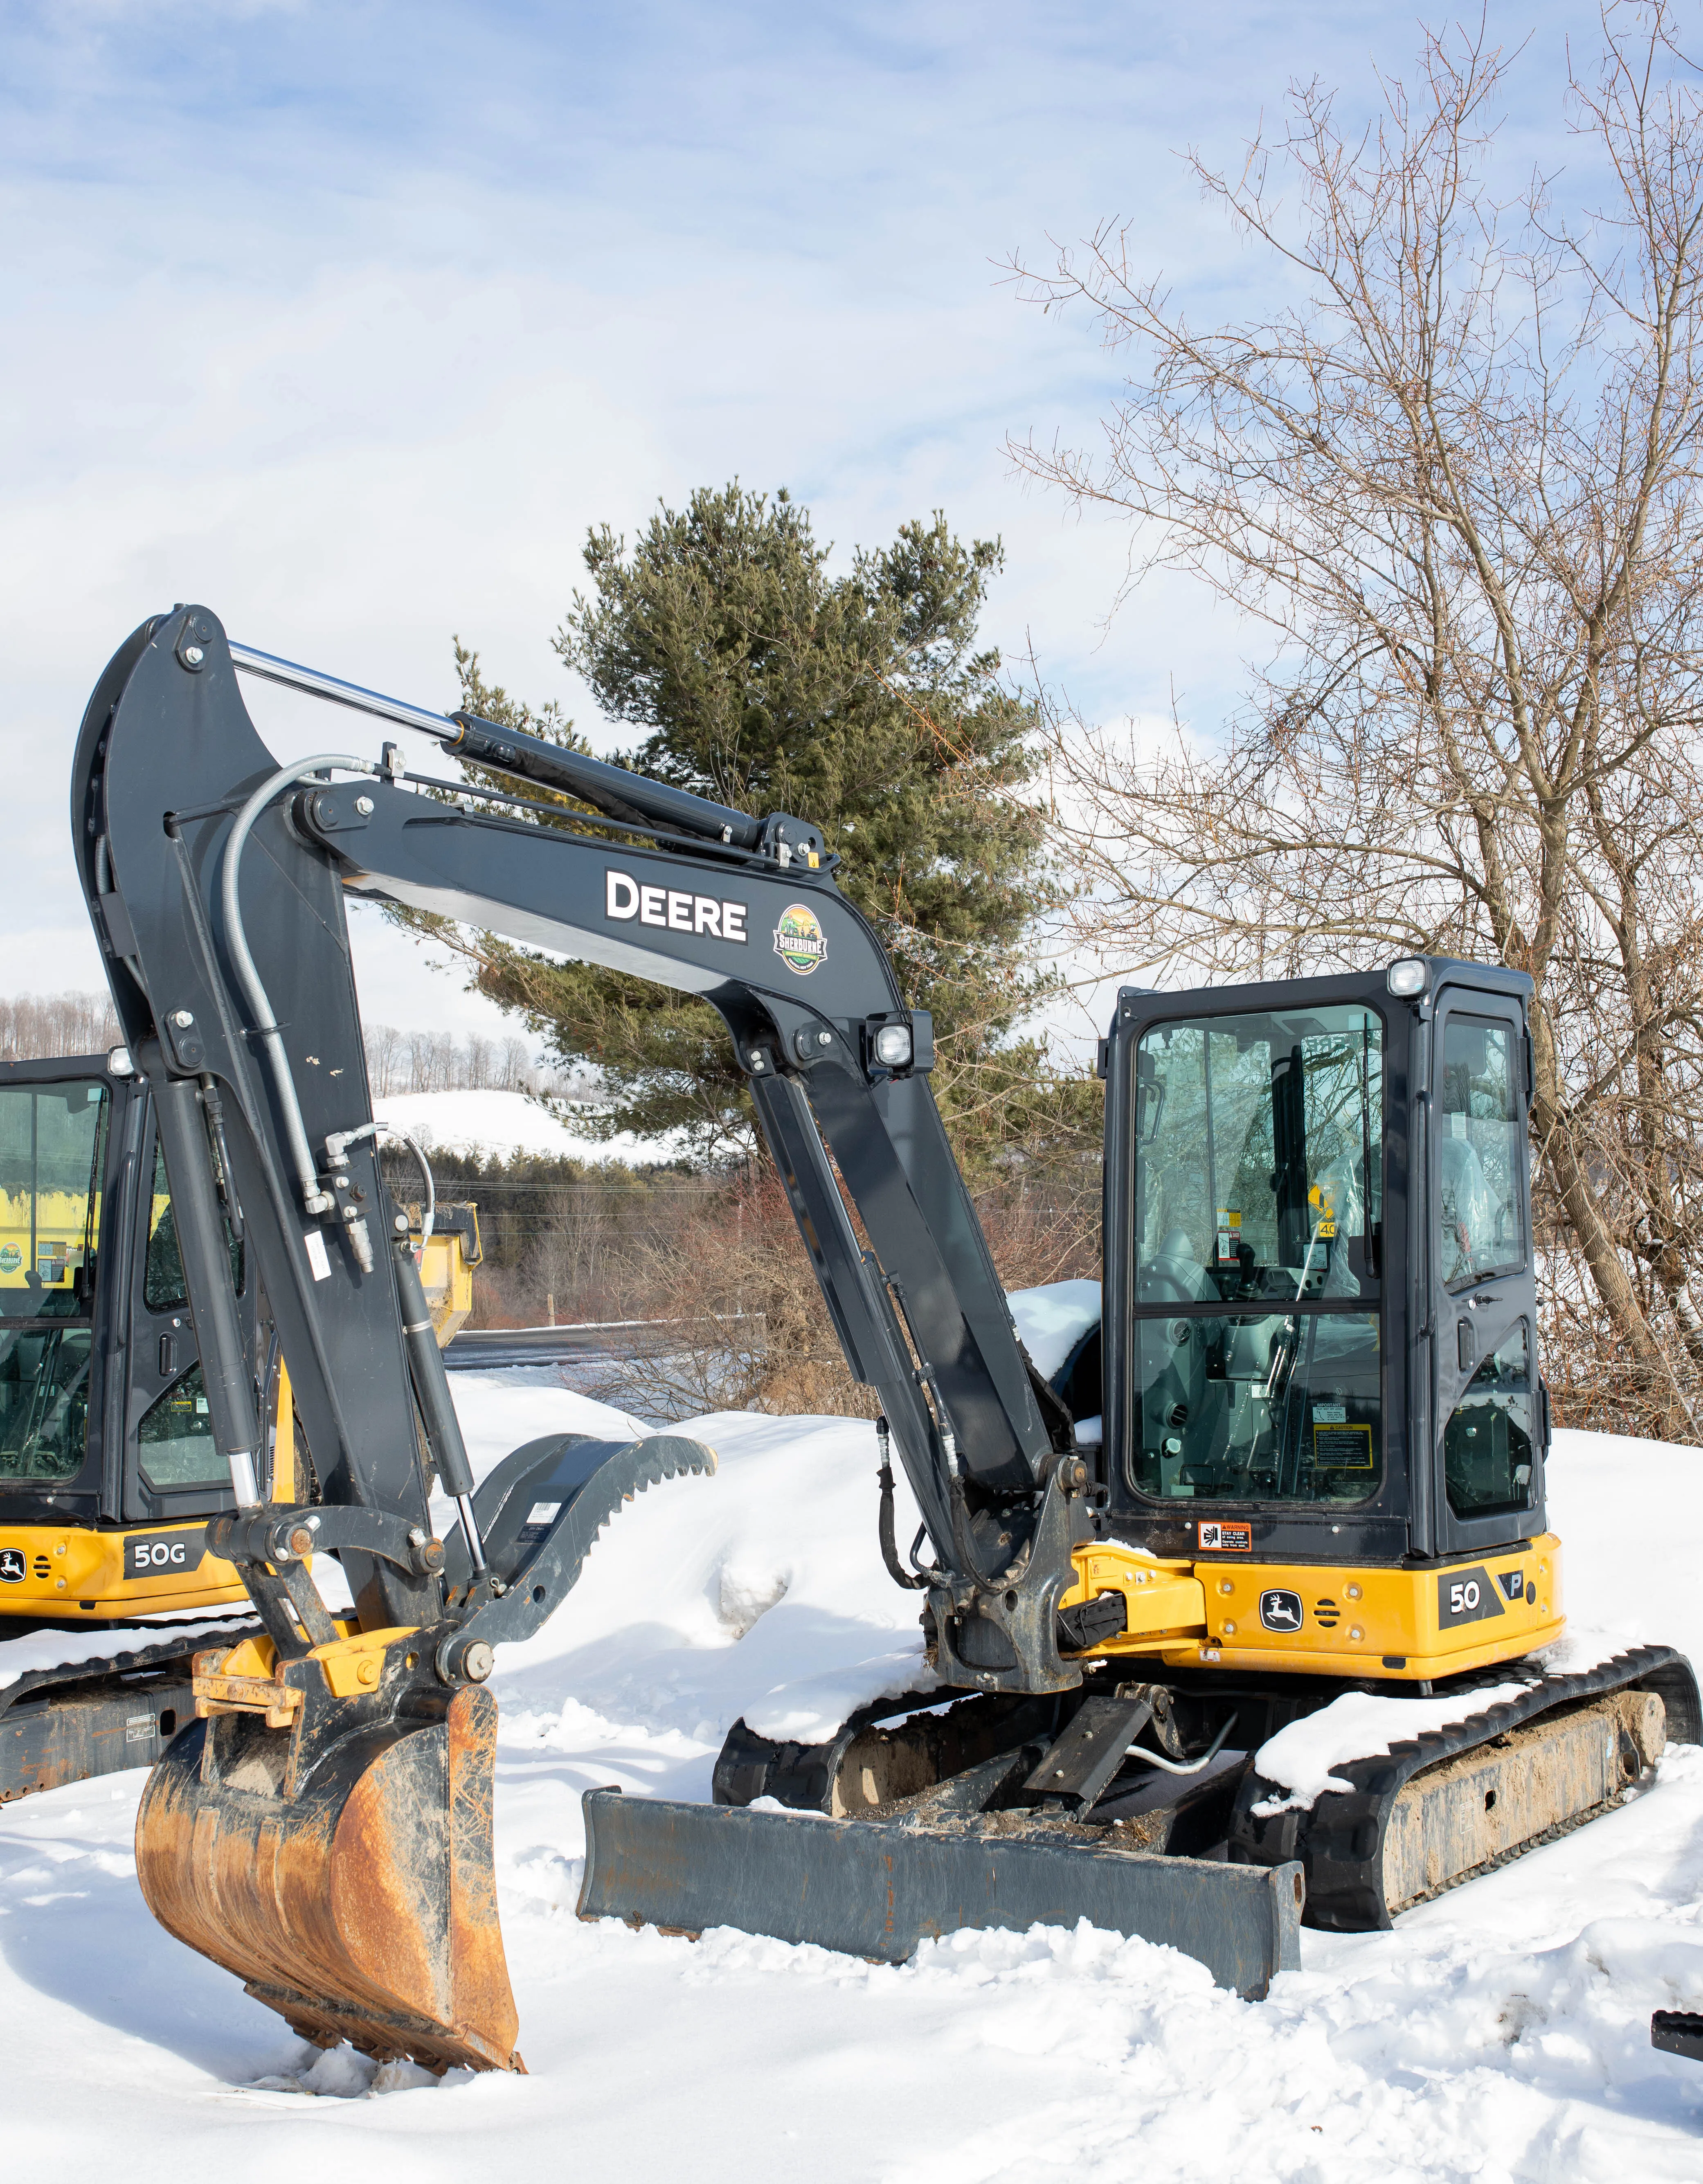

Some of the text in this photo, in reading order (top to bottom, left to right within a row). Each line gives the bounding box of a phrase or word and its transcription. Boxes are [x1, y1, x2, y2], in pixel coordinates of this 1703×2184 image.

[607, 870, 746, 941] DEERE
[779, 934, 822, 954] SHERBURNE
[788, 958, 800, 969] CENTRAL
[135, 1543, 185, 1568] 50G
[1451, 1574, 1521, 1613] 50 P
